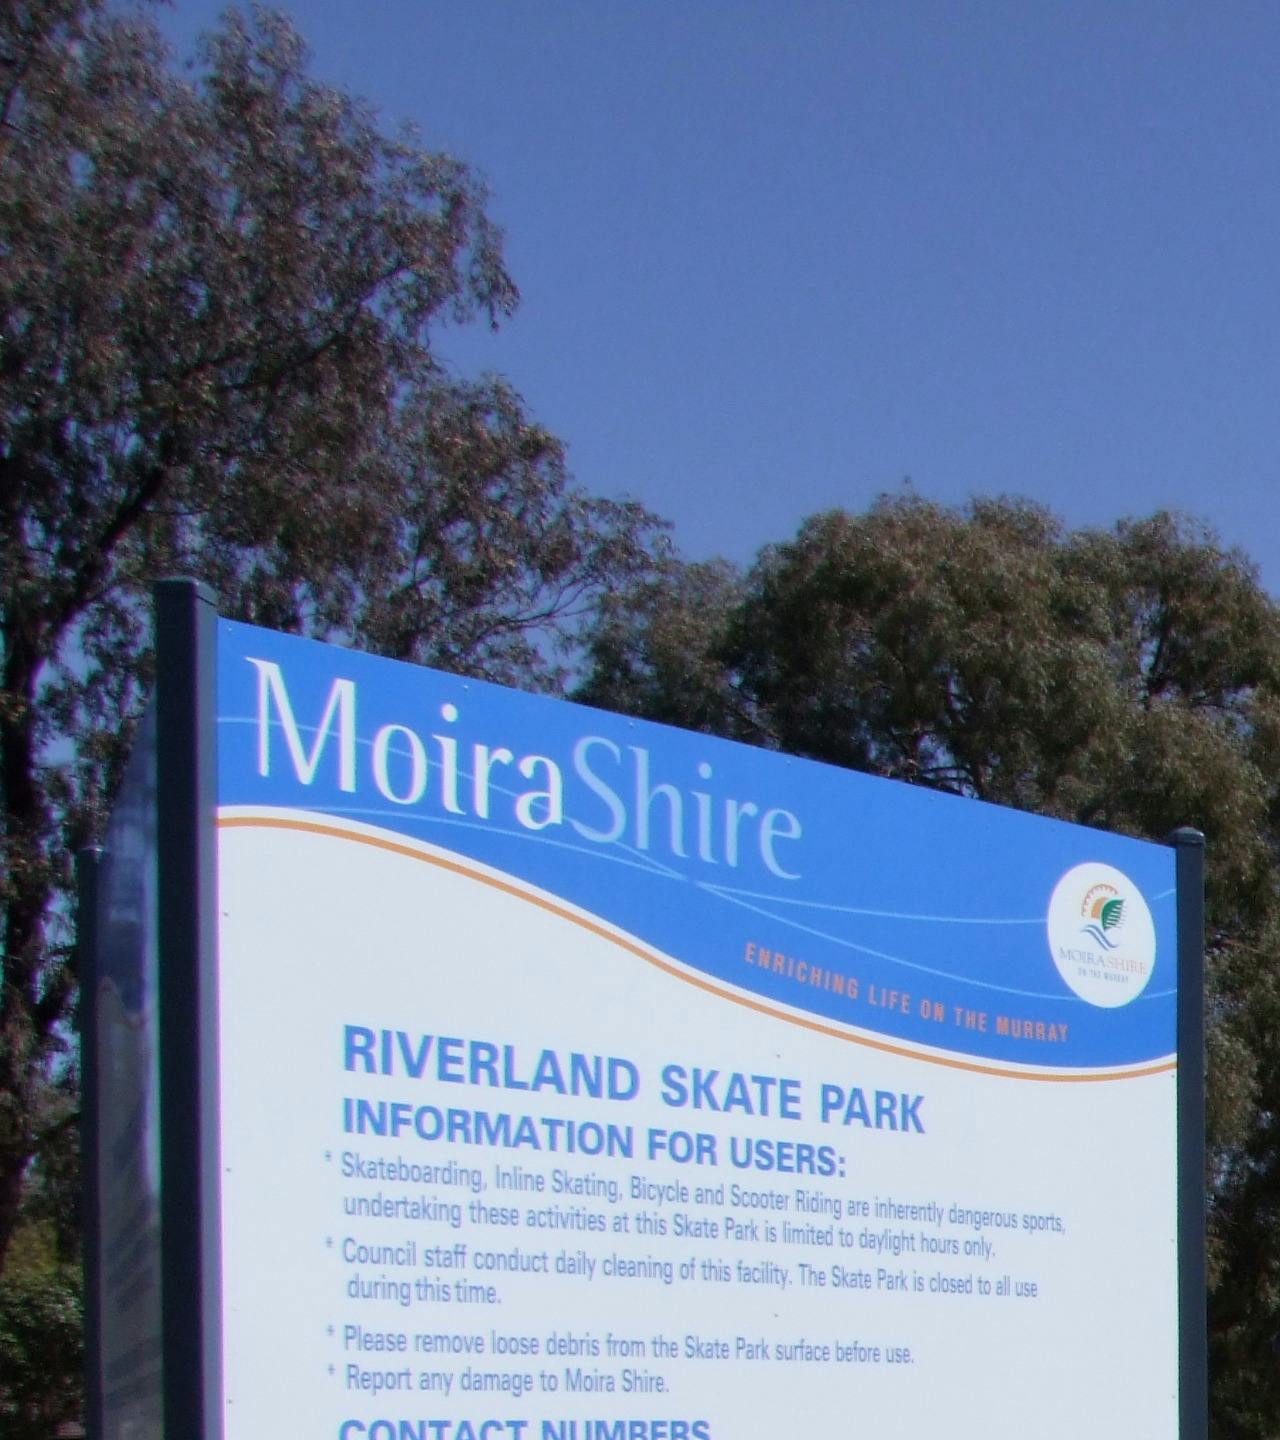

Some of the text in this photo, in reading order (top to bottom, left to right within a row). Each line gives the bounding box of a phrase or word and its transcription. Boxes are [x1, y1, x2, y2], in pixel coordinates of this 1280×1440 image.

[744, 943, 1069, 1042] ENRICHING LIFE ON THE MURRAY
[344, 1024, 925, 1134] RIVERLAND SKATE PARK
[343, 1097, 846, 1177] INFORMATION FOR USERS:
[342, 1151, 487, 1193] Skateboarding,
[495, 1164, 545, 1192] Inline
[631, 1176, 689, 1206] Bicycle
[695, 1183, 725, 1206] and
[730, 1184, 790, 1211] Scooter
[797, 1190, 842, 1219] Riding
[848, 1199, 870, 1216] are
[875, 1196, 944, 1226] inherently
[949, 1202, 1018, 1231] dangerous
[344, 1192, 996, 1260] undertaking these activities at this Skate Park is limited to daylight hours only.
[342, 1237, 1038, 1298] Council staff conduct daily cleaning of this facility. The Skate Park is closed to all use
[347, 1274, 501, 1306] during this time.
[344, 1325, 914, 1363] Please remove loose debris from the Skate Park surface before use.
[347, 1364, 669, 1397] Report any damage to Moira Shire.
